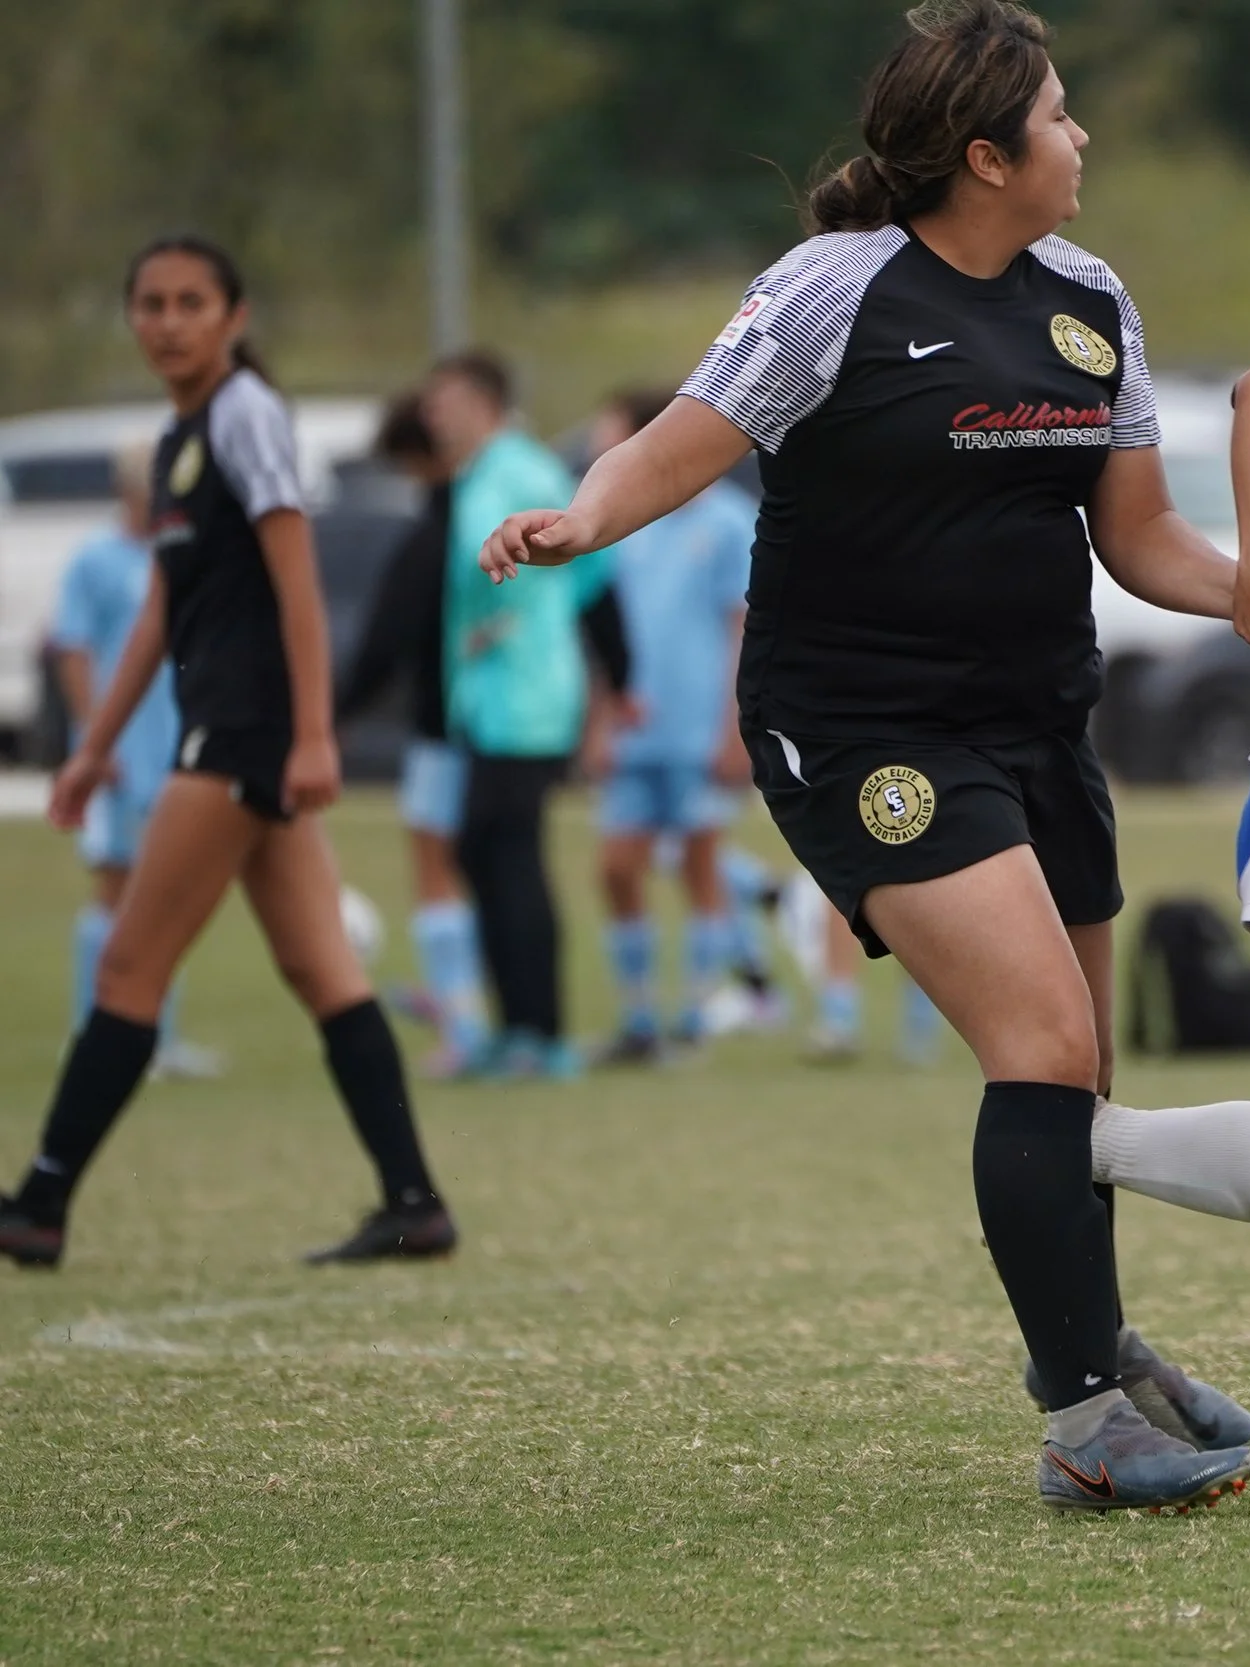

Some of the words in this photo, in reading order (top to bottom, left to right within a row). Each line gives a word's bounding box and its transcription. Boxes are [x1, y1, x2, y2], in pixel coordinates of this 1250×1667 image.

[1103, 350, 1114, 370] CLUB
[950, 427, 1112, 449] TRANSMISSIO
[862, 771, 888, 802] SOCAL
[889, 768, 919, 783] ELITE
[869, 821, 920, 842] FOOTBALL
[917, 798, 933, 827] CLUB
